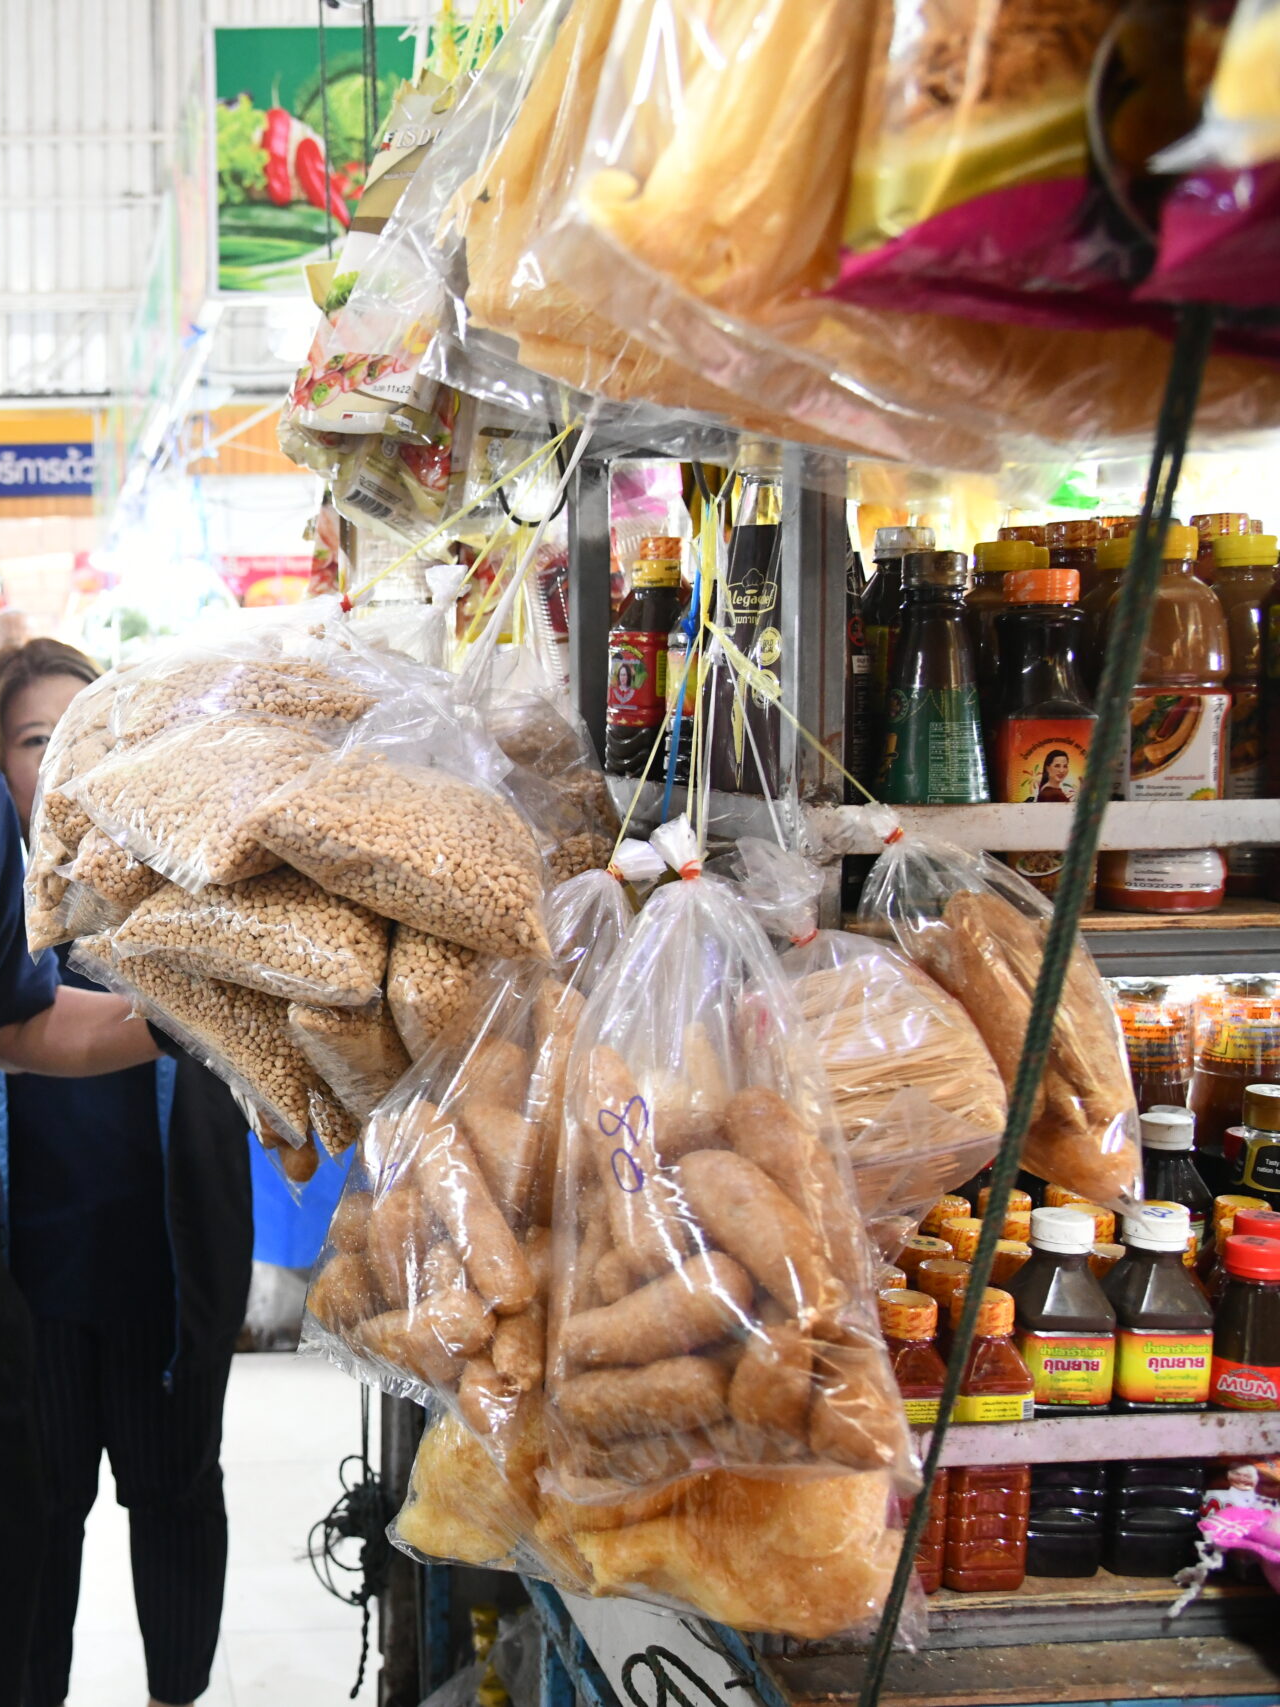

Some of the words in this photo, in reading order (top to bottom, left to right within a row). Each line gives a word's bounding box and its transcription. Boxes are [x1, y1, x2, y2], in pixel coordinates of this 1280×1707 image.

[1043, 1358, 1102, 1374] คุณยาย
[1148, 1356, 1206, 1373] คุณยาย
[1217, 1374, 1277, 1400] MUM
